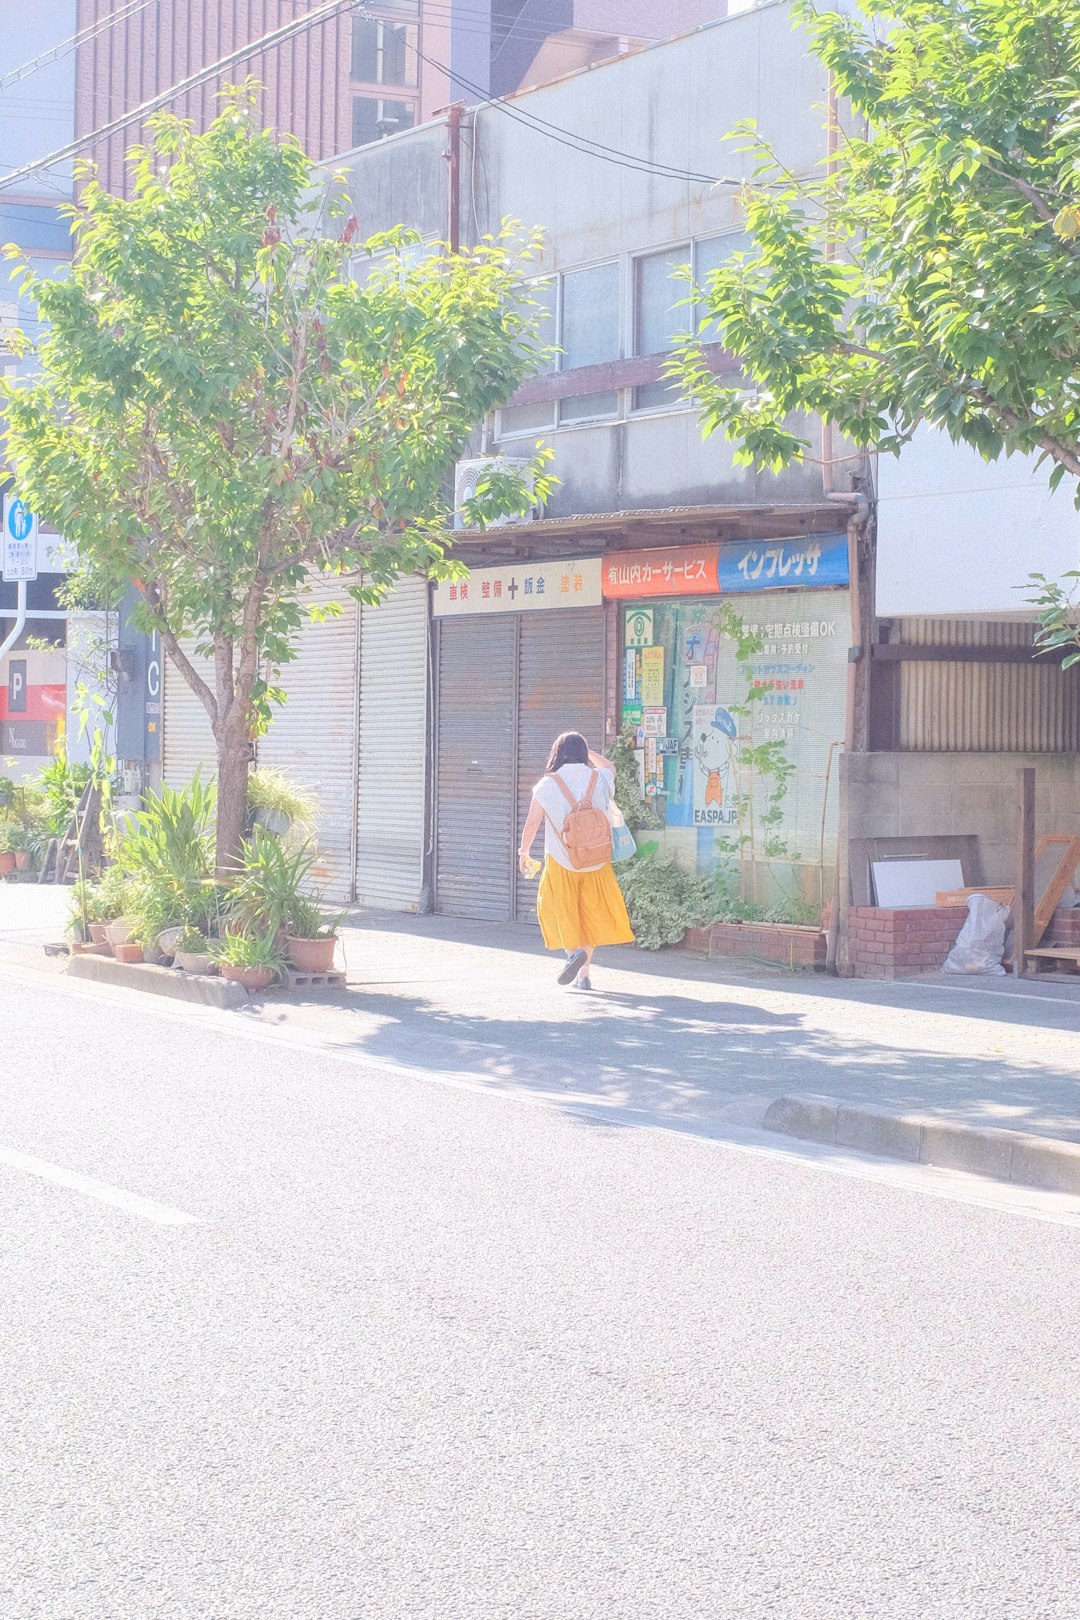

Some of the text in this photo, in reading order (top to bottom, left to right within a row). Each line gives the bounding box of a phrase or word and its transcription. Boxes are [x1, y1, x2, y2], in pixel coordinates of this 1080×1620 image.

[449, 574, 583, 601] 車検 整備 鈑金 塗装
[13, 673, 22, 699] P
[665, 740, 678, 750] JAF
[694, 809, 738, 823] EASPA.JP
